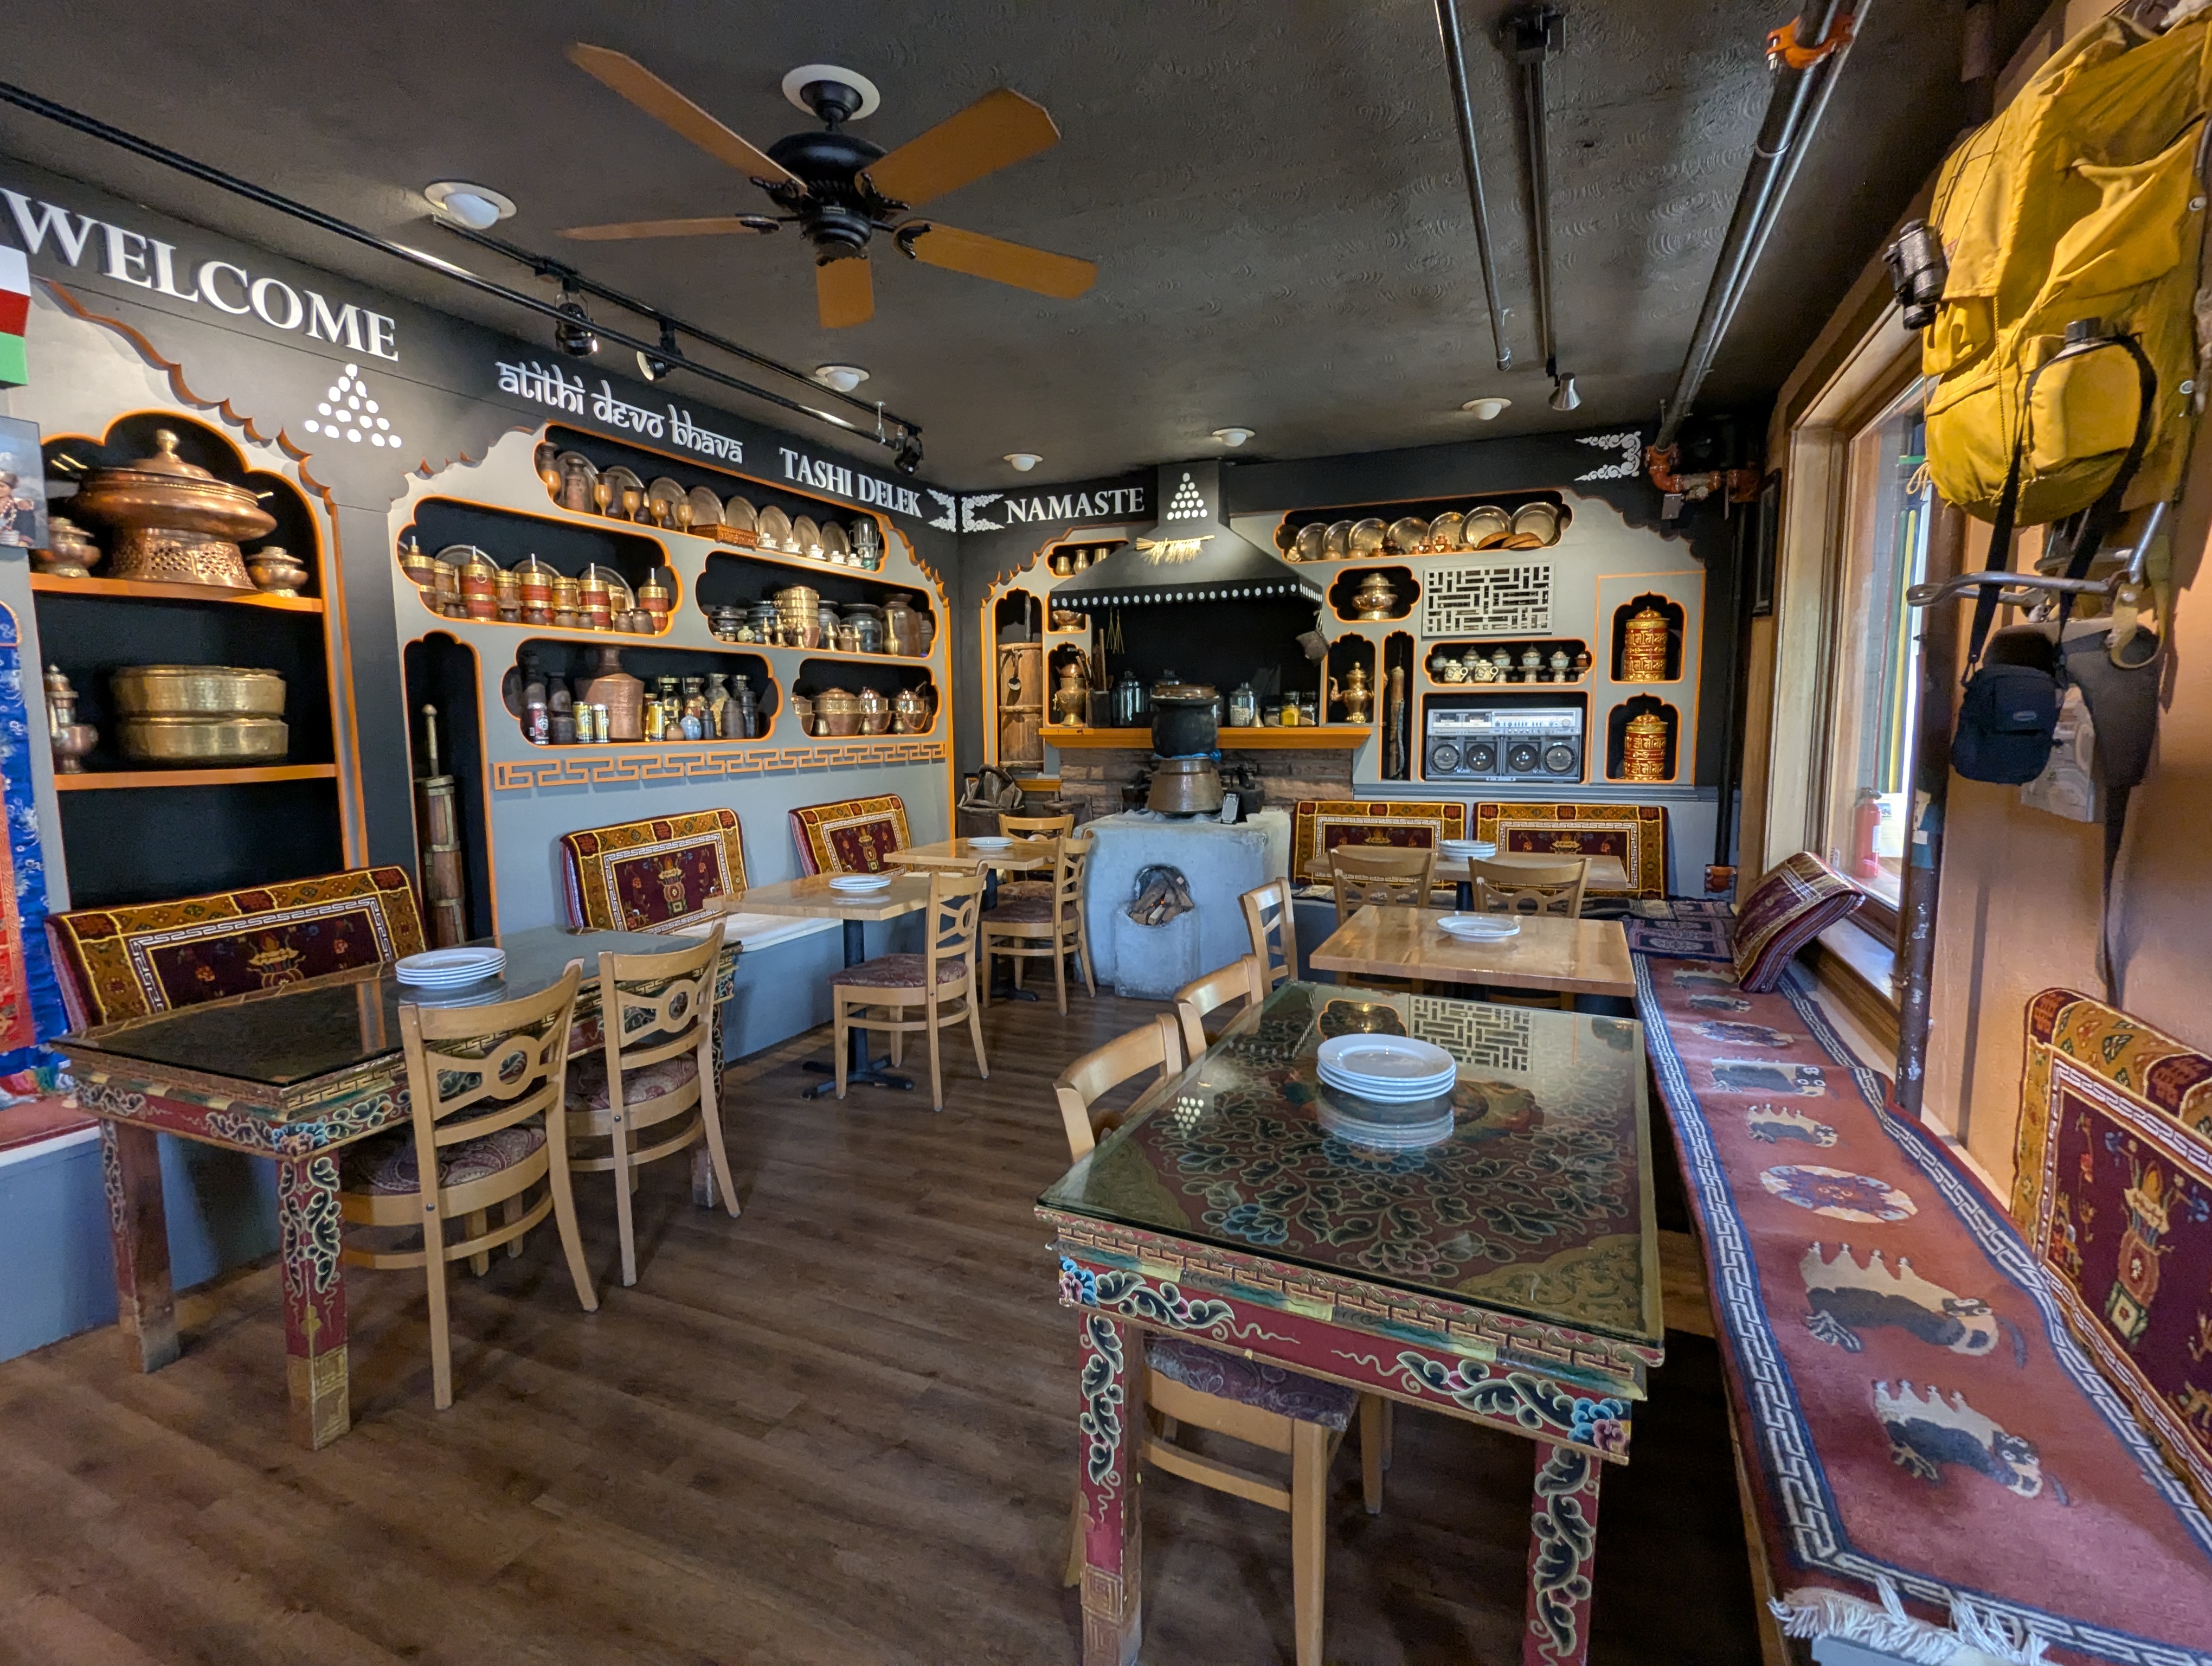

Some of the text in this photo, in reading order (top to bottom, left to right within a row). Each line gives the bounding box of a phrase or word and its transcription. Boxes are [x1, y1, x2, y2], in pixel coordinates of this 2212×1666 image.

[2, 188, 398, 362] WELCOME
[495, 361, 743, 464] atithi devo bhava
[779, 447, 923, 518] TASHI DELEK
[1004, 488, 1145, 524] NAMASTE
